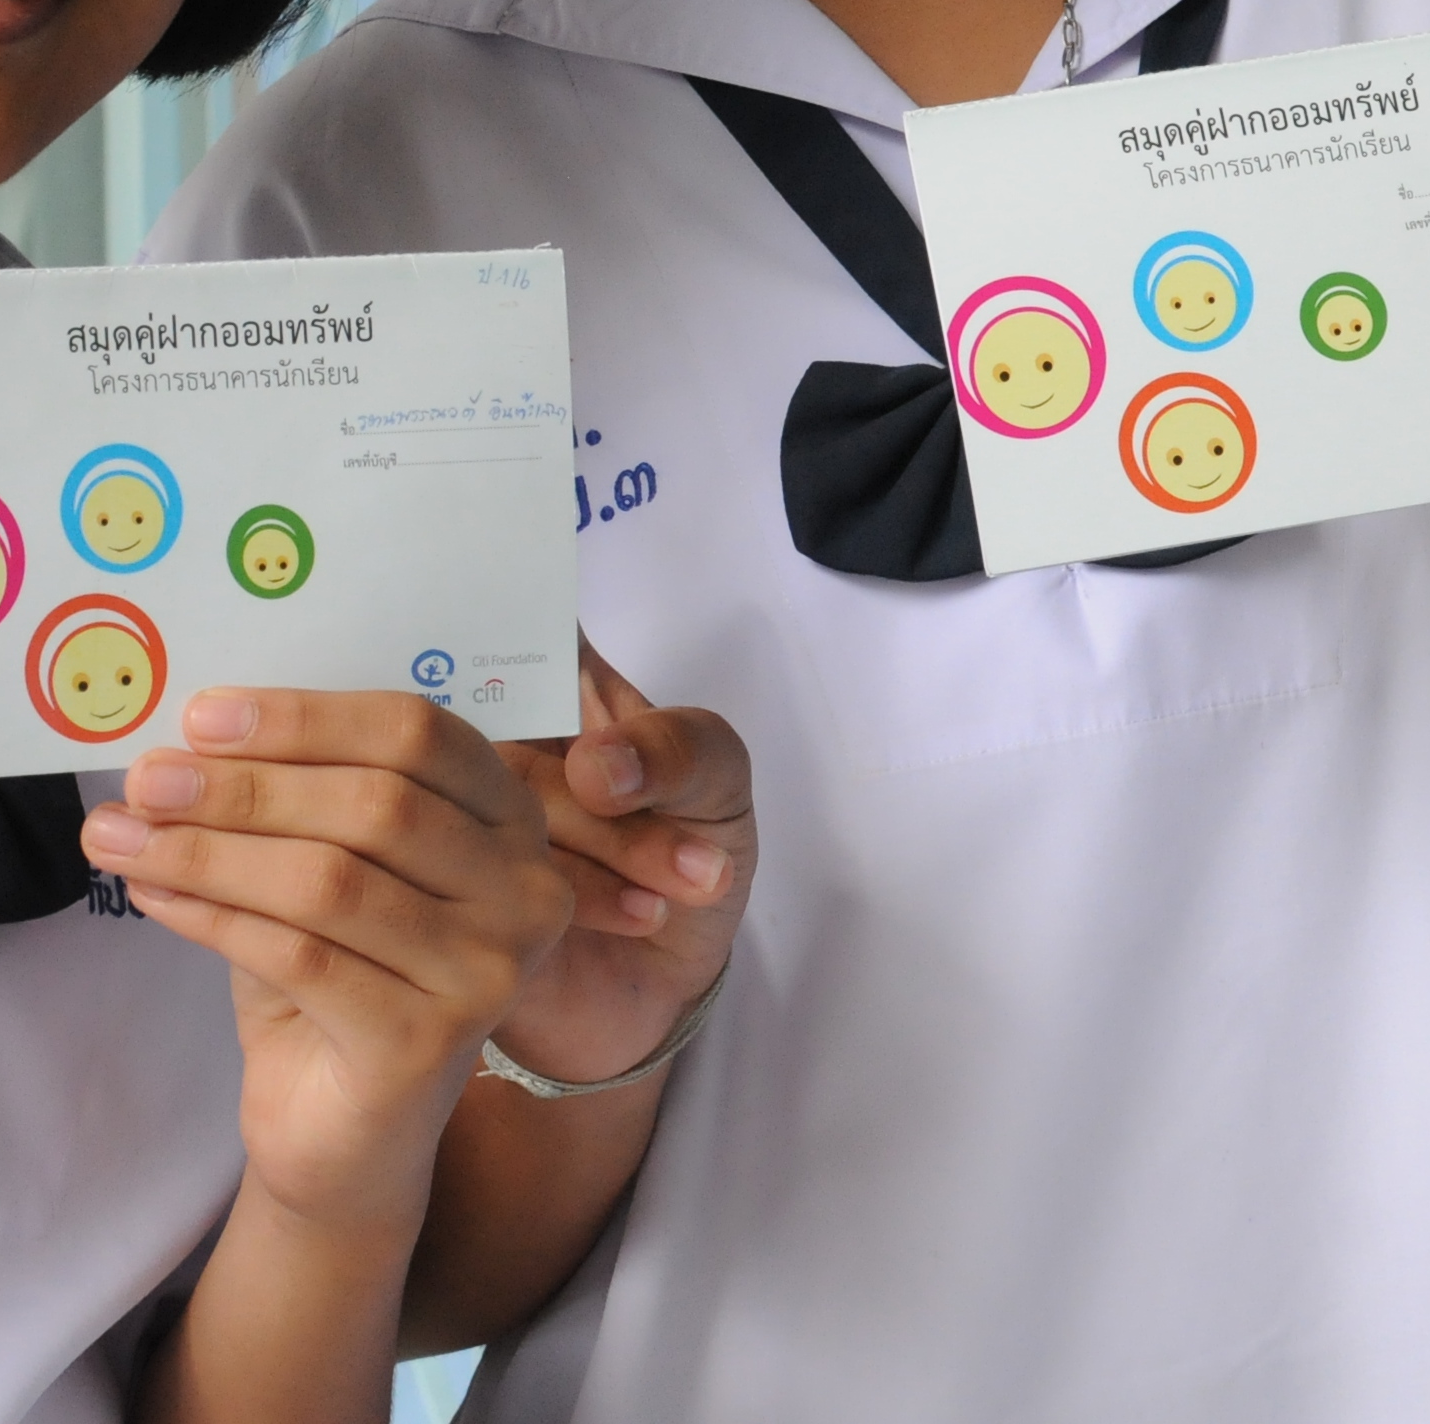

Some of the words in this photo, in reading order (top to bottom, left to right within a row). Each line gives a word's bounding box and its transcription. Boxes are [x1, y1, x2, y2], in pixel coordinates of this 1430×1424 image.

[1118, 73, 1420, 162] สมุดคู่ฝากออมทรัพย์
[1143, 129, 1412, 189] โครงการธนาคารนักเรียน
[67, 301, 373, 366] สมุดคู่ฝากออมทรัพย์
[87, 357, 359, 395] โครงการธนาคารนักเรียน
[472, 655, 489, 668] Citi
[491, 652, 548, 666] Foundation
